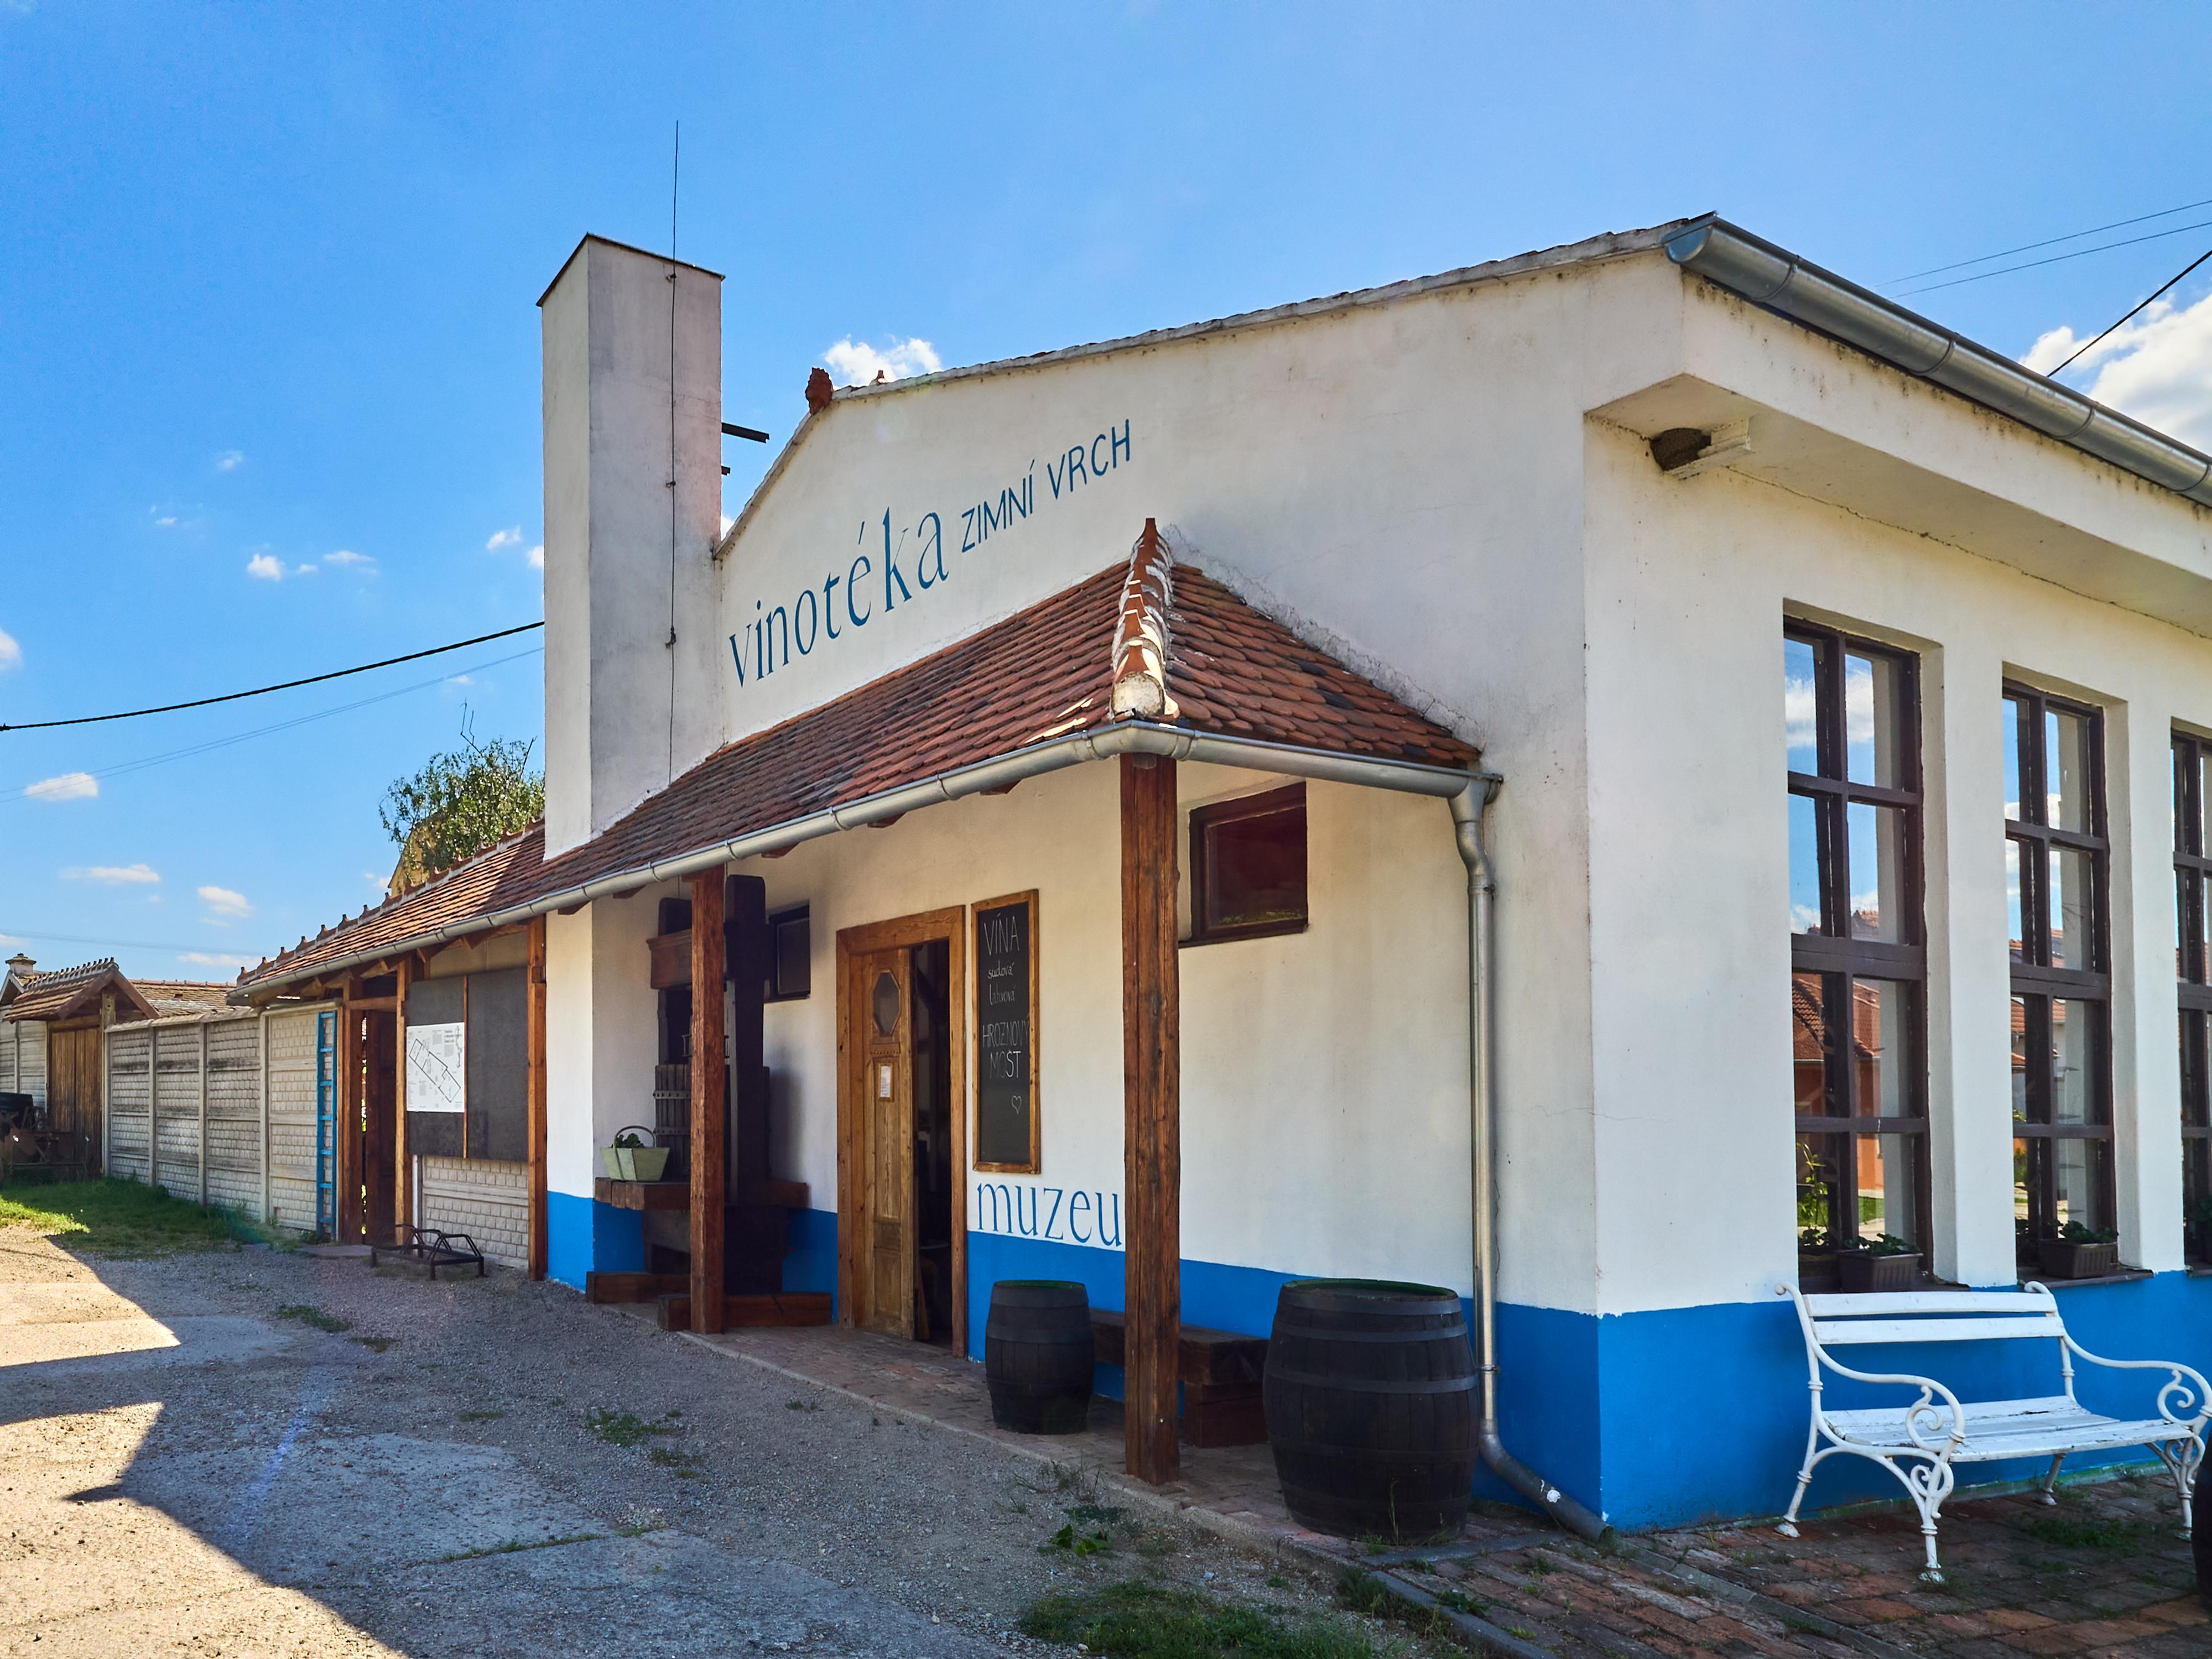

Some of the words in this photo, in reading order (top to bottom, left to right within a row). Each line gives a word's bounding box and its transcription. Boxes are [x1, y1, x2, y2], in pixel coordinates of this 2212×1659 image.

[729, 507, 949, 688] vinotéka
[961, 459, 1035, 552] ZIMNÍ
[1047, 419, 1130, 499] VRCH
[984, 913, 1019, 956] VÍNA
[977, 1183, 1122, 1246] muzeu
